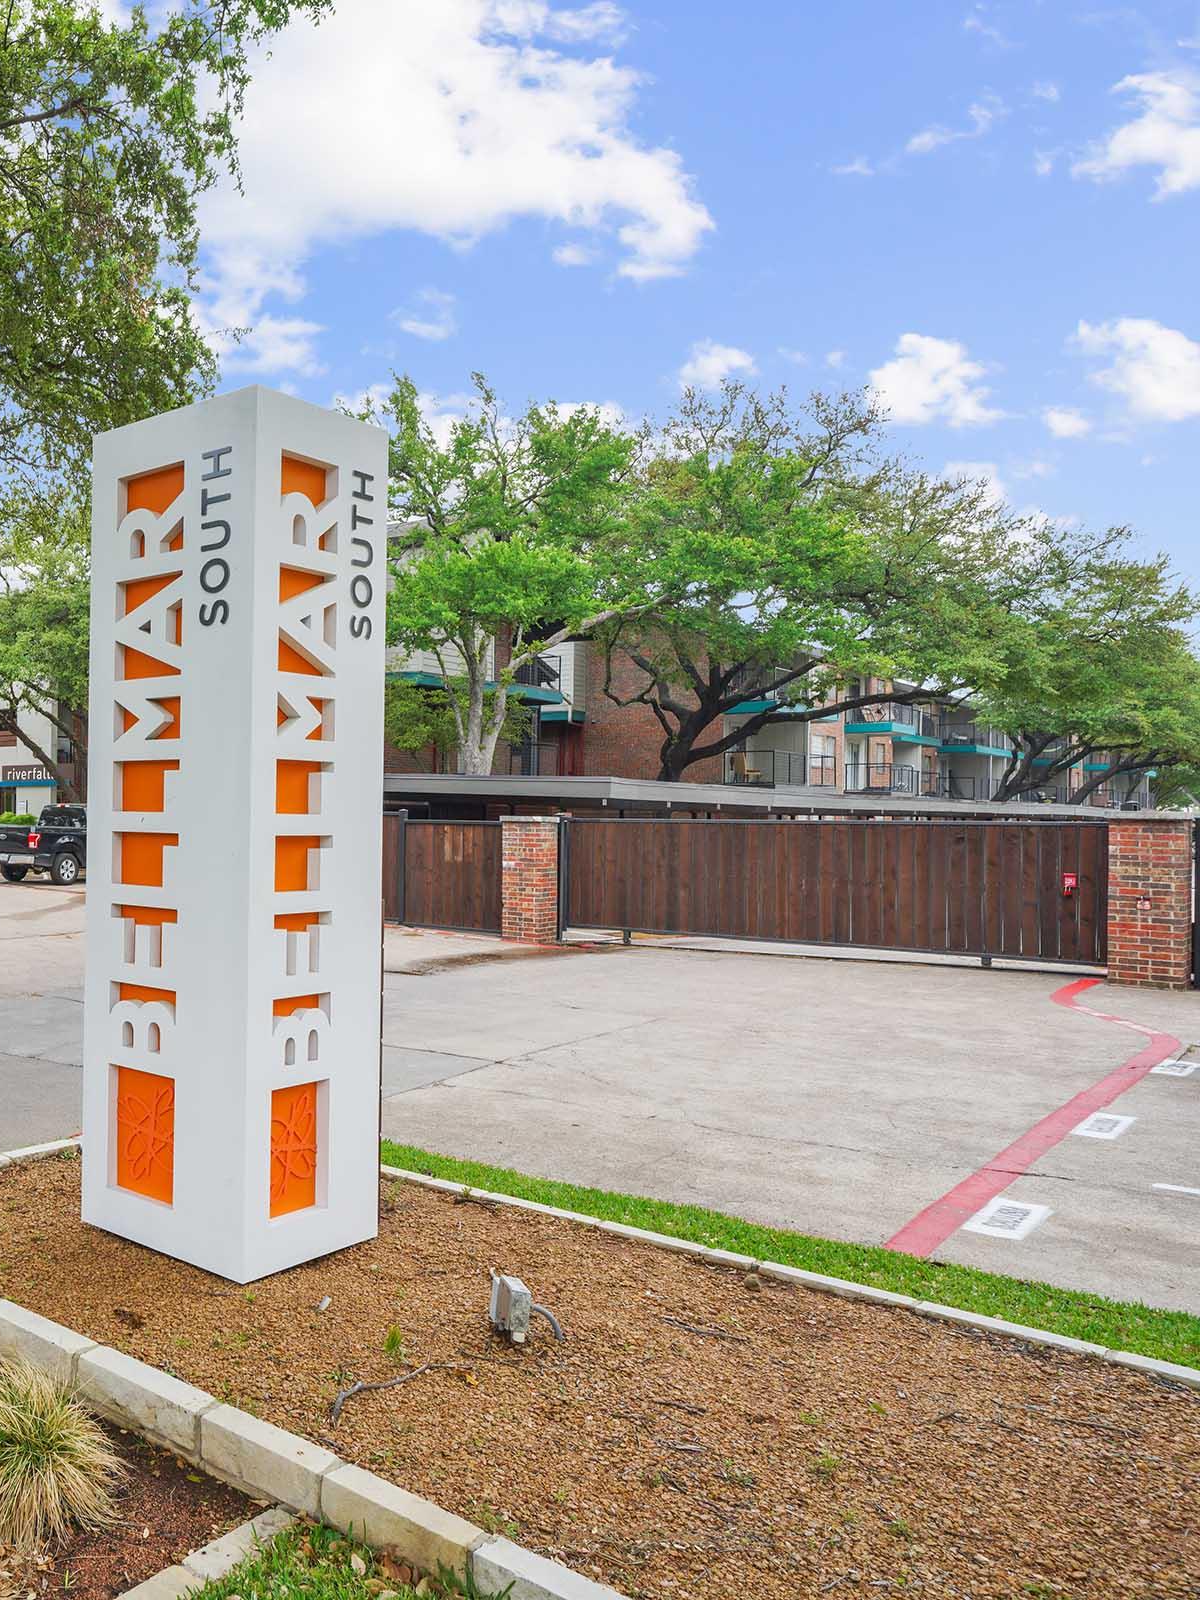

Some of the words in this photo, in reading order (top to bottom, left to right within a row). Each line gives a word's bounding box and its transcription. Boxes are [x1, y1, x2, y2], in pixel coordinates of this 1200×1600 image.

[199, 445, 232, 627] SOUTH
[350, 470, 375, 641] SOUTH
[109, 480, 186, 1074] BELLMAR
[271, 488, 339, 1088] BELLMAR
